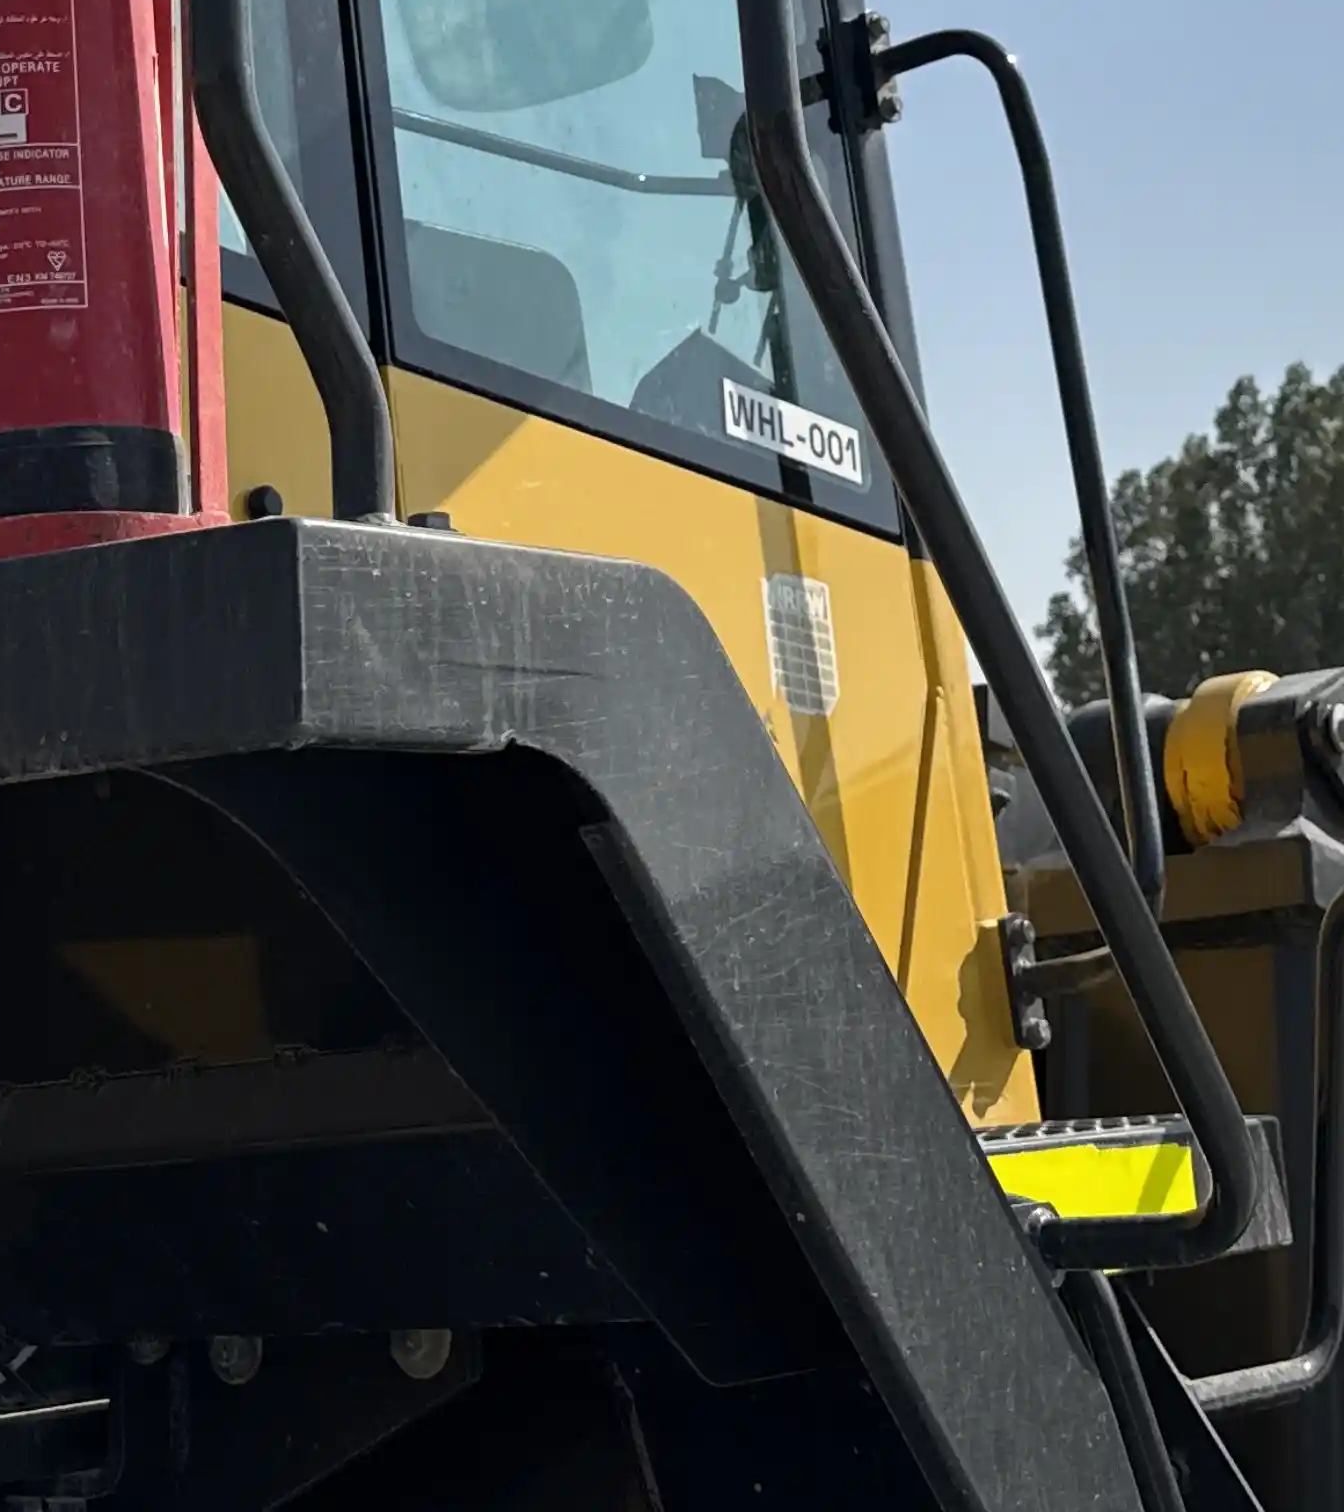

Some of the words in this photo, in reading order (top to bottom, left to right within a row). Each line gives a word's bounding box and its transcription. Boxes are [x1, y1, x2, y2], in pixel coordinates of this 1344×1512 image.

[1, 60, 61, 74] OPERATE
[4, 93, 23, 112] C
[13, 148, 70, 161] INDICATOR
[35, 174, 73, 185] RANGE
[728, 390, 858, 472] WHL-001
